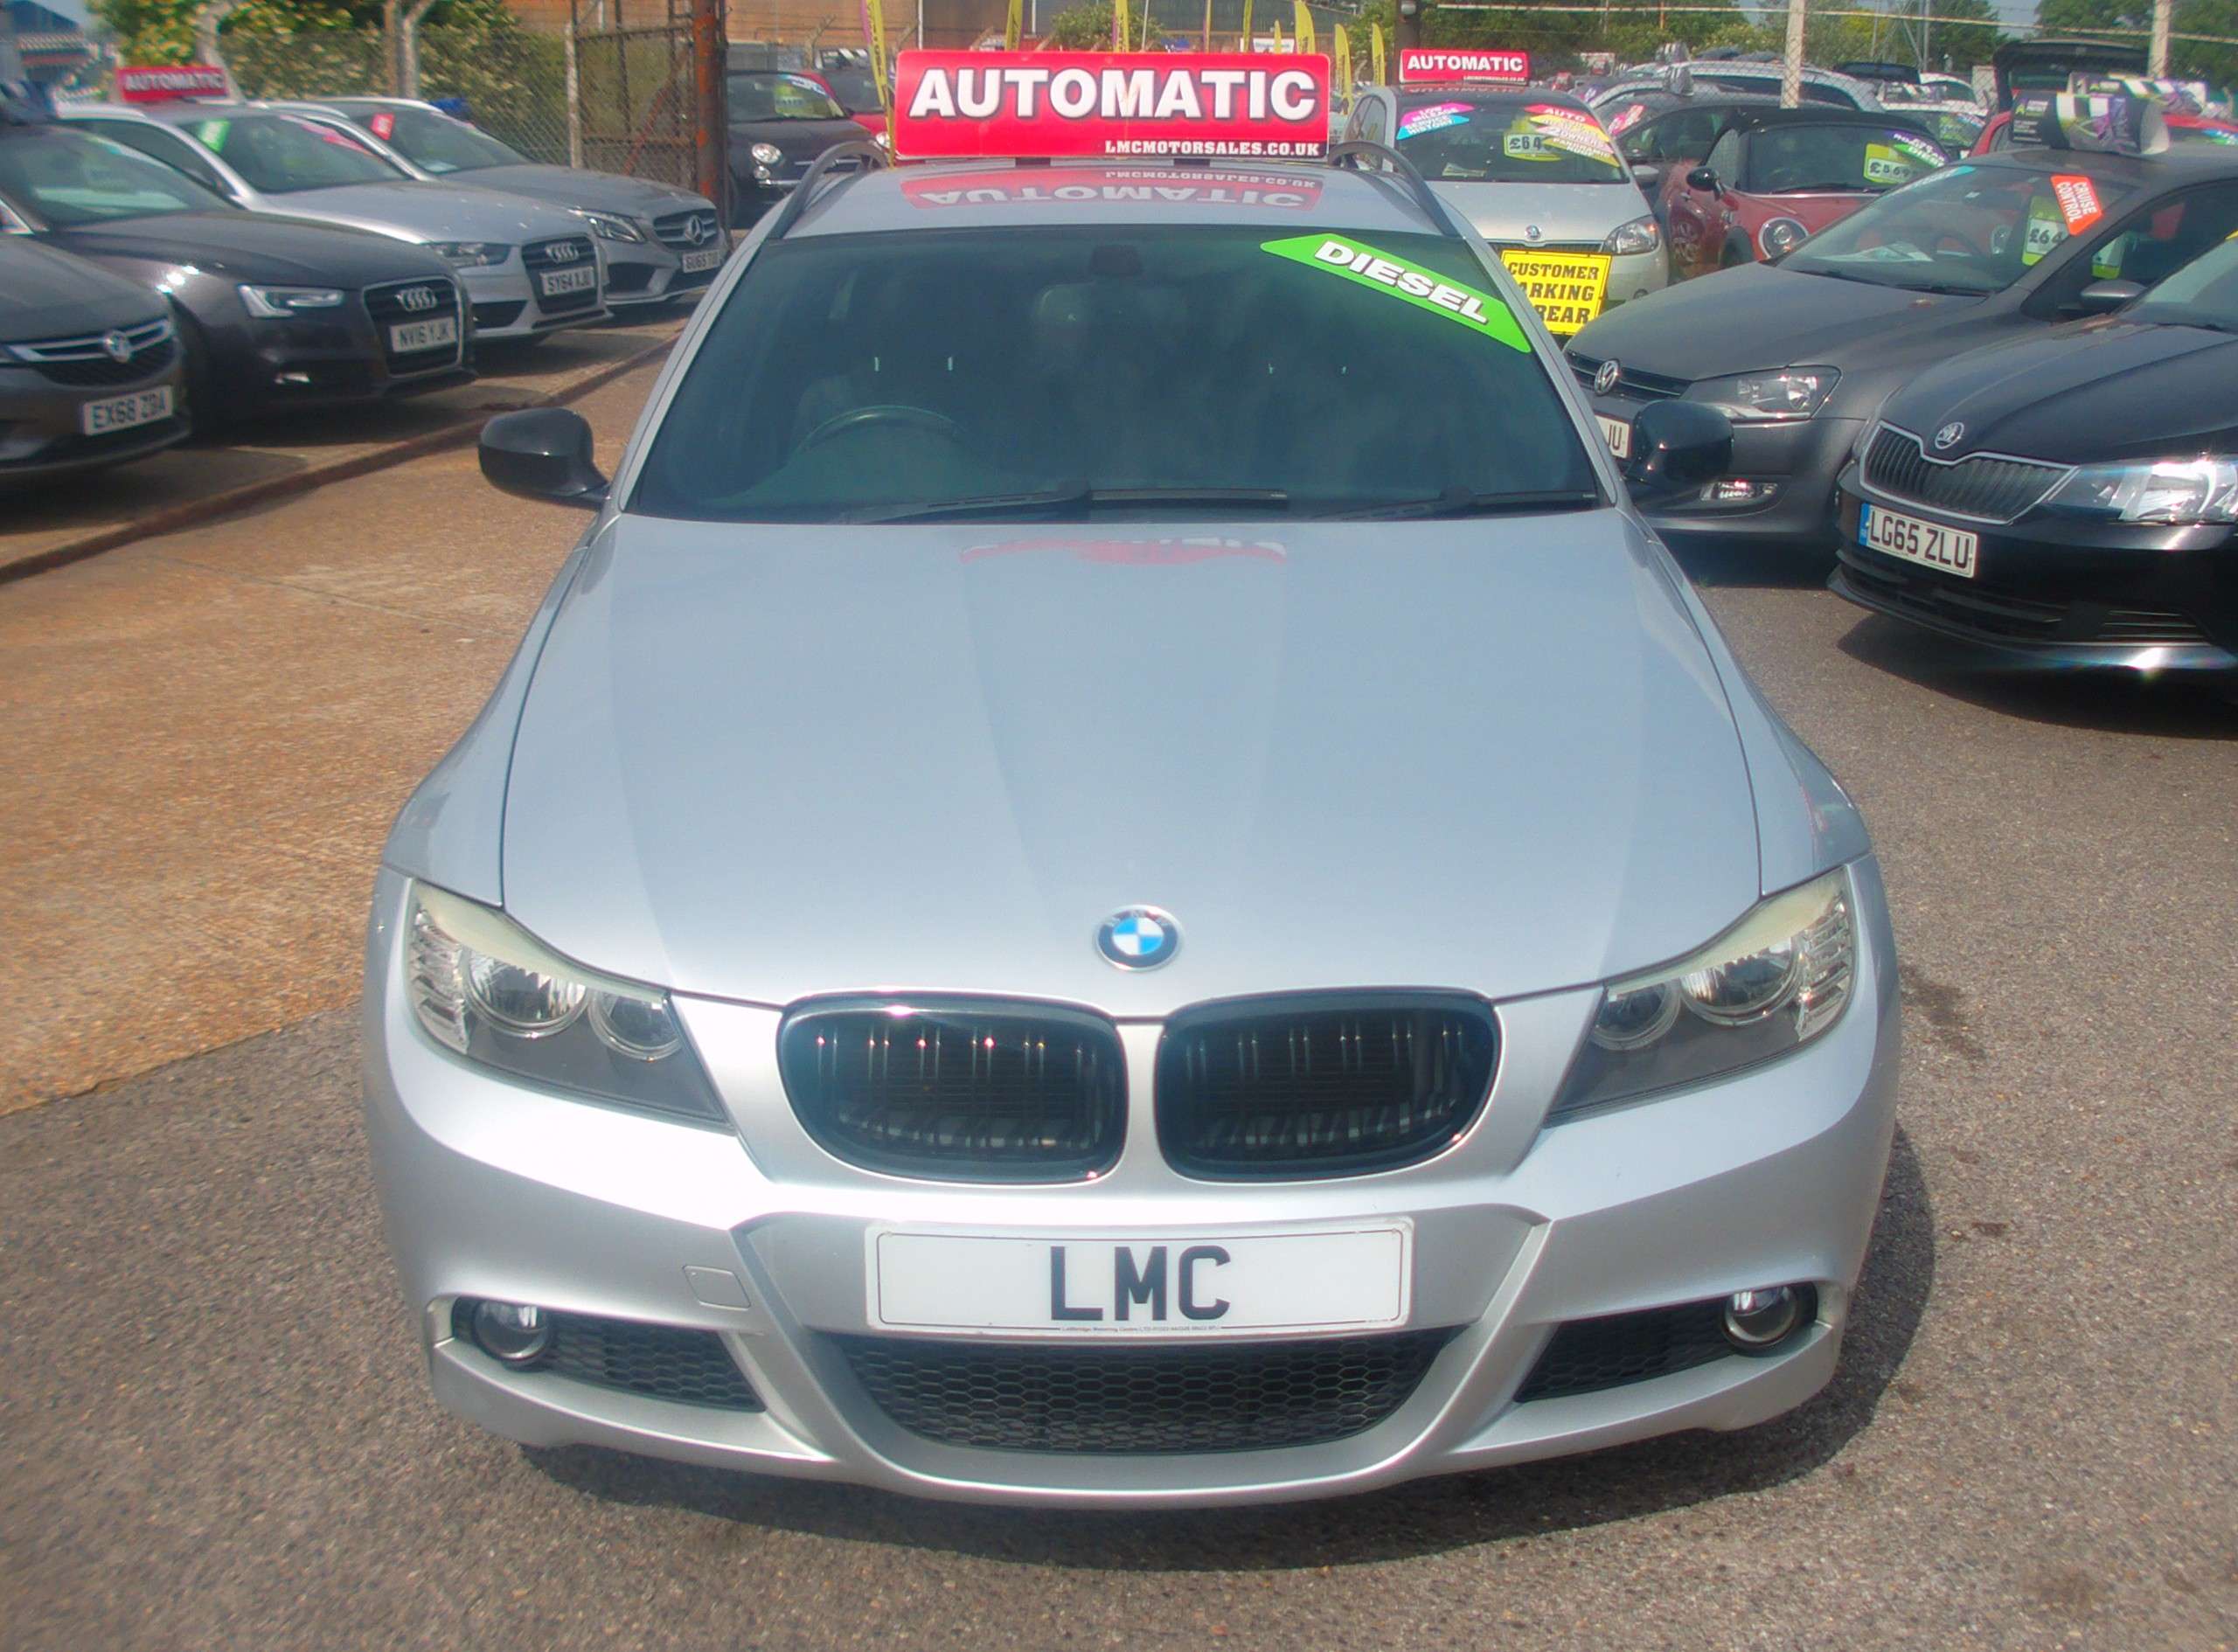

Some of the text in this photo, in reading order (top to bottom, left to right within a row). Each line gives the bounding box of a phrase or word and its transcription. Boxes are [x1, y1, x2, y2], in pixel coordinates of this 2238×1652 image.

[1407, 55, 1523, 72] AUTOMATIC
[909, 69, 1316, 119] AUTOMATIC
[1544, 108, 1586, 121] AUTO
[1105, 140, 1320, 156] LMCMOTORSALES.CO.UK
[2055, 182, 2084, 223] CONTROL
[2073, 182, 2098, 215] CRUISE
[1314, 240, 1489, 324] DIESEL
[1508, 262, 1599, 280] CUSTOMER
[1519, 281, 1595, 302] ARKING
[1869, 510, 1970, 569] LG65 ZLU
[1050, 1245, 1231, 1321] LMC
